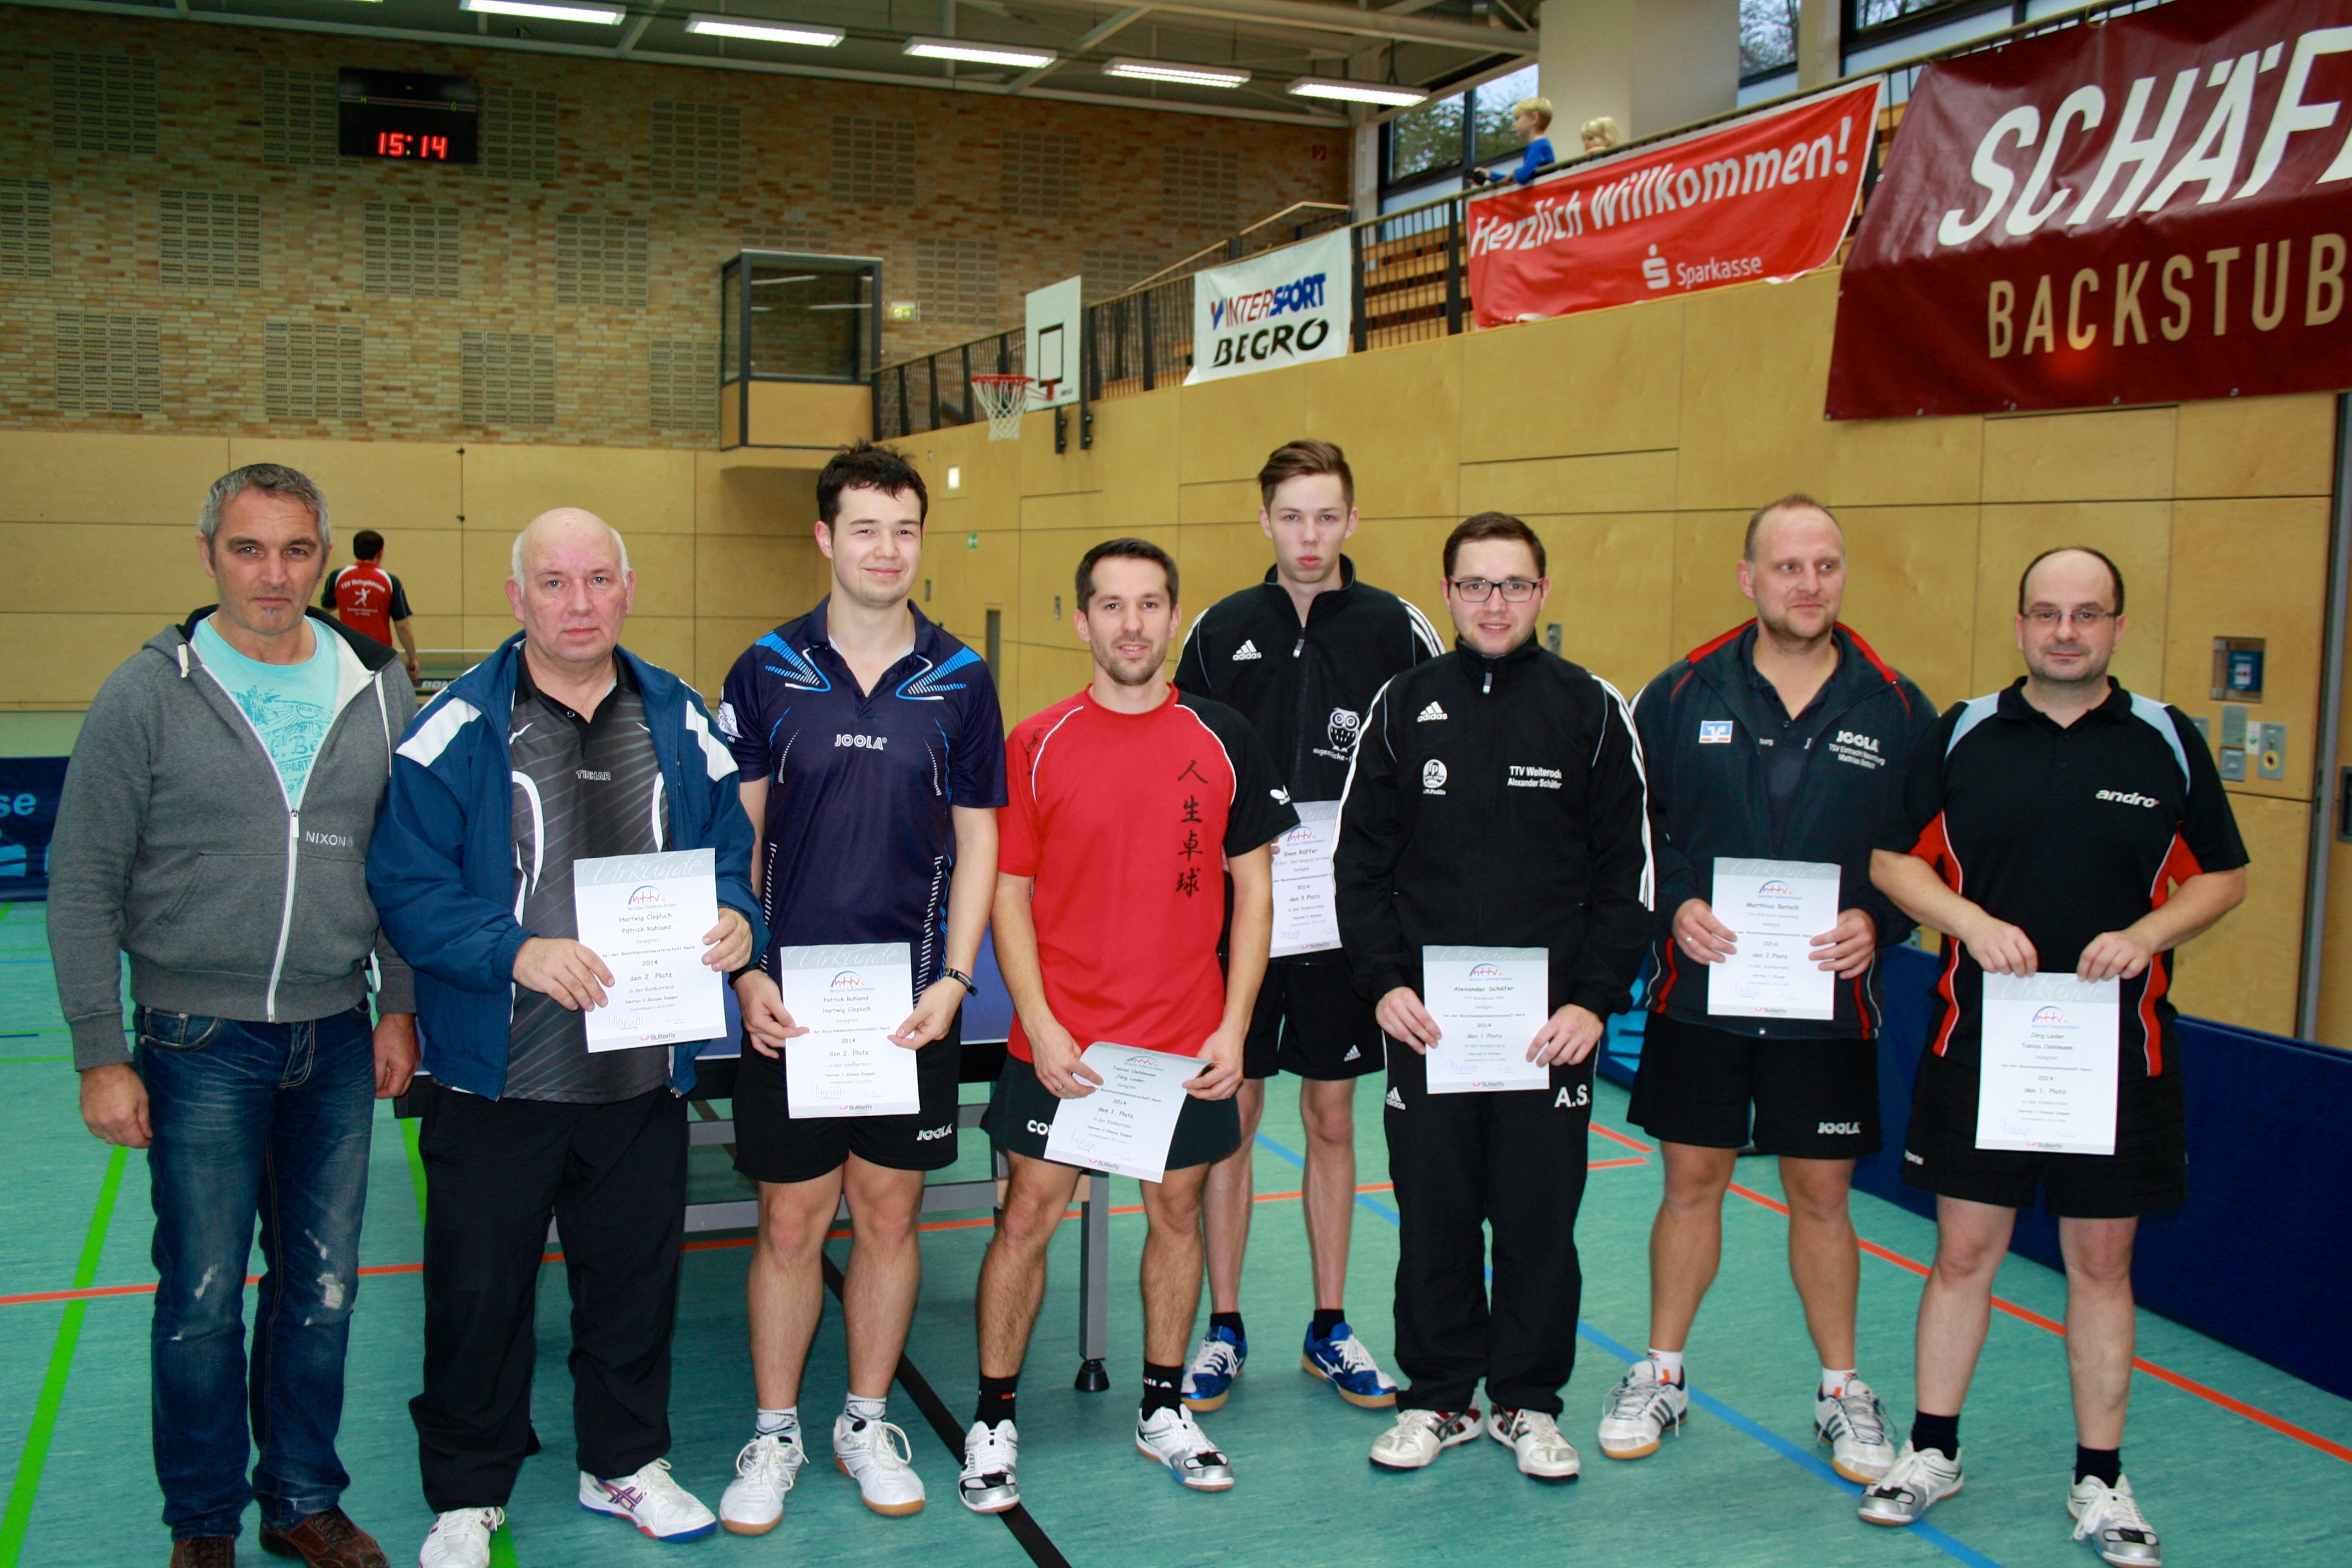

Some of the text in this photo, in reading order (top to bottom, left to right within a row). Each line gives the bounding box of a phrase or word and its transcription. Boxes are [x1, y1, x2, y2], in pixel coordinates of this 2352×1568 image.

[359, 95, 368, 105] H
[377, 131, 448, 159] 15:14
[1469, 116, 1852, 258] Herzlich Willkommen!
[1676, 255, 1763, 289] Sparkasse
[1224, 272, 1327, 327] INTERSPORT
[1988, 234, 2347, 359] BACKSTUB
[1210, 317, 1330, 368] BEGRO
[1232, 652, 1262, 661] adidas
[1416, 712, 1448, 723] adidas
[835, 734, 884, 751] JOOLA
[1835, 730, 1879, 753] JOOLA
[576, 769, 612, 781] TIBHAR
[1509, 765, 1526, 777] TTV
[1506, 777, 1538, 788] Alexander
[2095, 789, 2156, 808] andro
[305, 831, 347, 847] NIXON
[647, 923, 671, 932] Ruhland
[847, 1005, 872, 1013] Ciepluch
[650, 1032, 676, 1040] Butterfly
[1119, 1111, 1134, 1119] Platz
[916, 1123, 953, 1142] JOOLA
[1817, 1121, 1860, 1135] JOOLA
[1097, 1160, 1120, 1171] Butterfly
